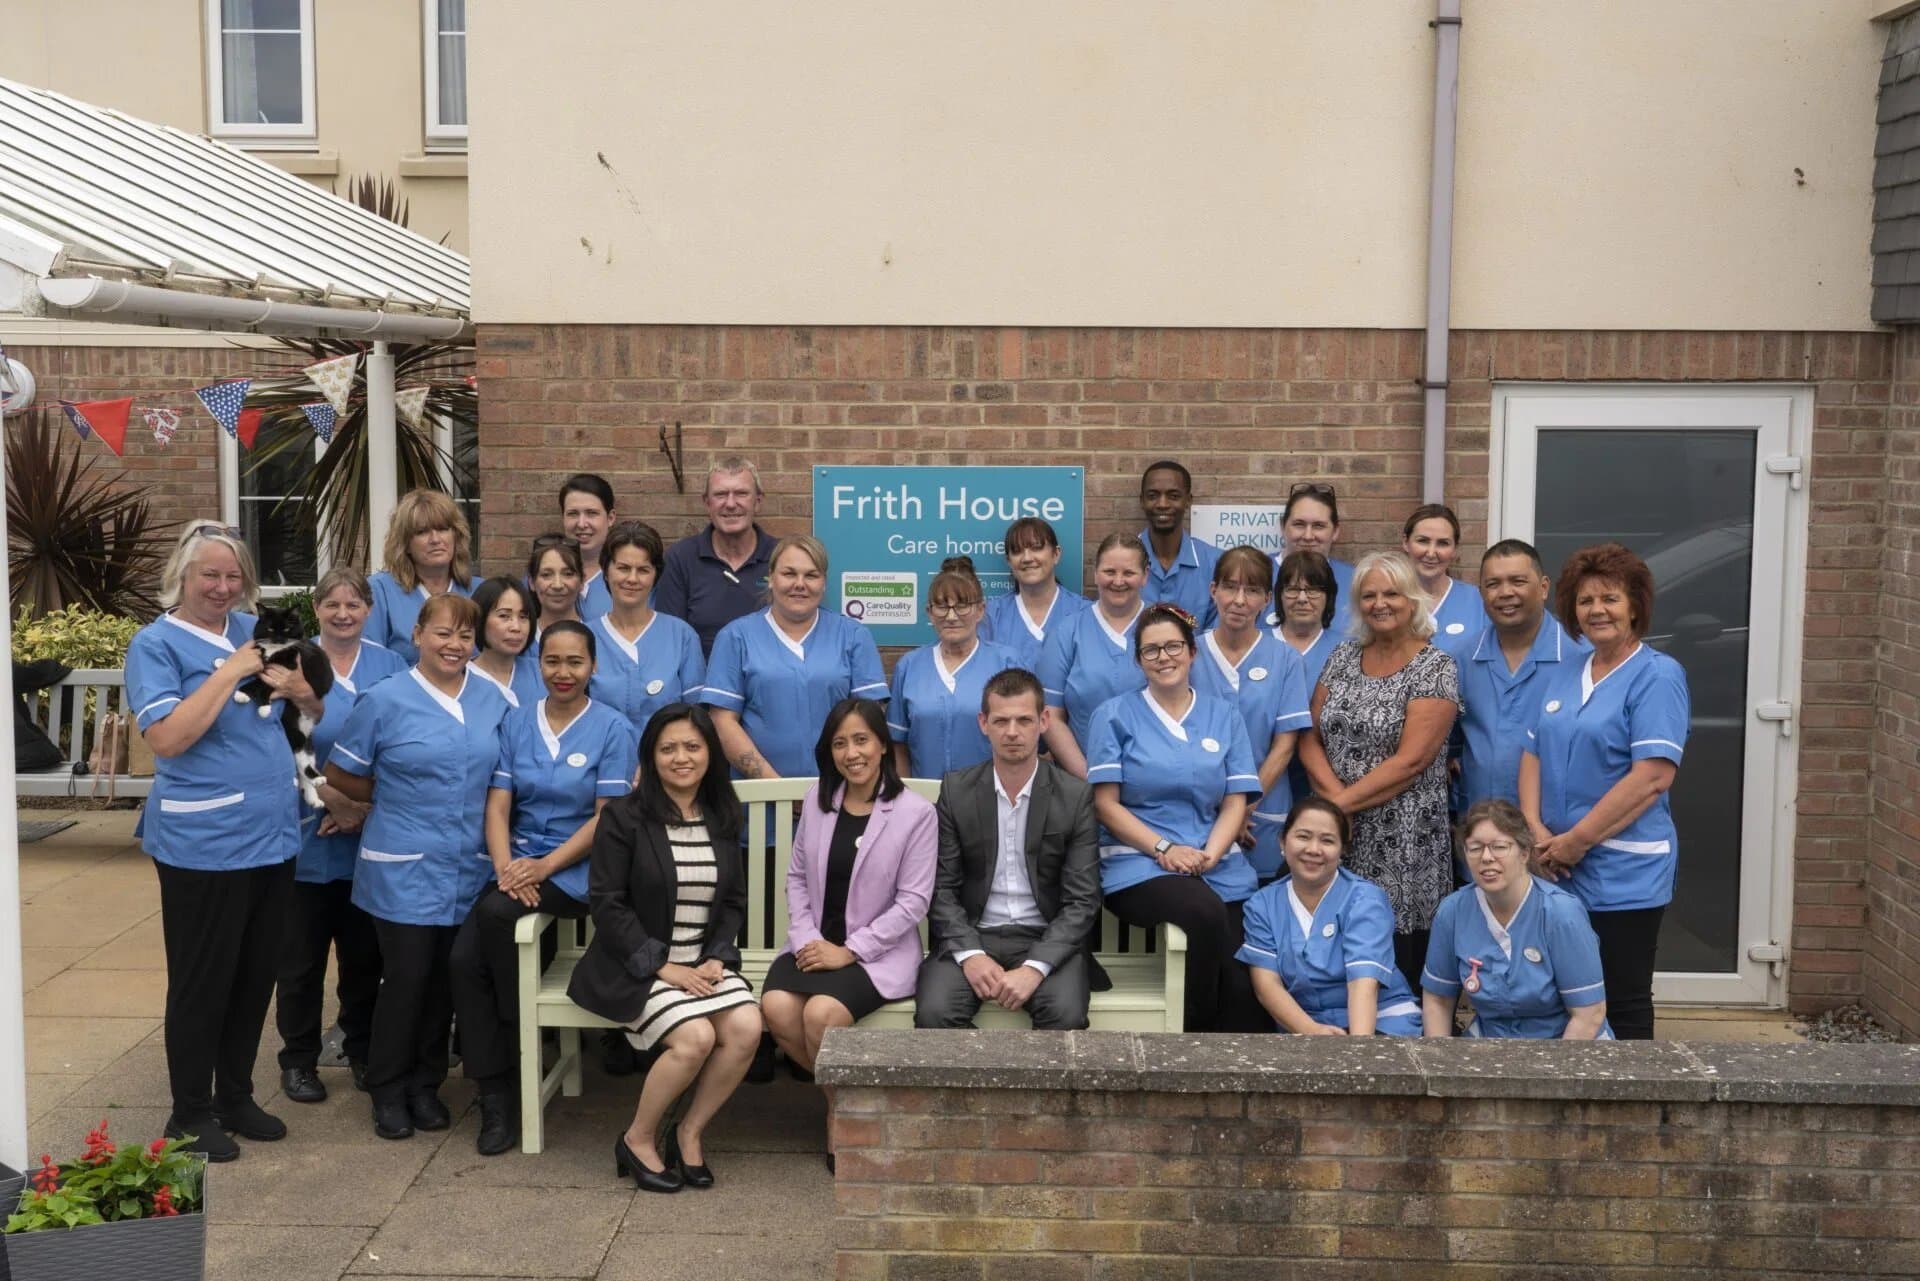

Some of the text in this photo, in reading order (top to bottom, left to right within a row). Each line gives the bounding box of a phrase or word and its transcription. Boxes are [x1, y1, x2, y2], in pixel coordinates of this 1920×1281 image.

[833, 484, 1065, 521] Frith House
[887, 533, 1005, 554] Care home
[848, 585, 895, 596] Outstanding
[866, 601, 912, 611] CareQuality
[866, 610, 912, 618] Commission
